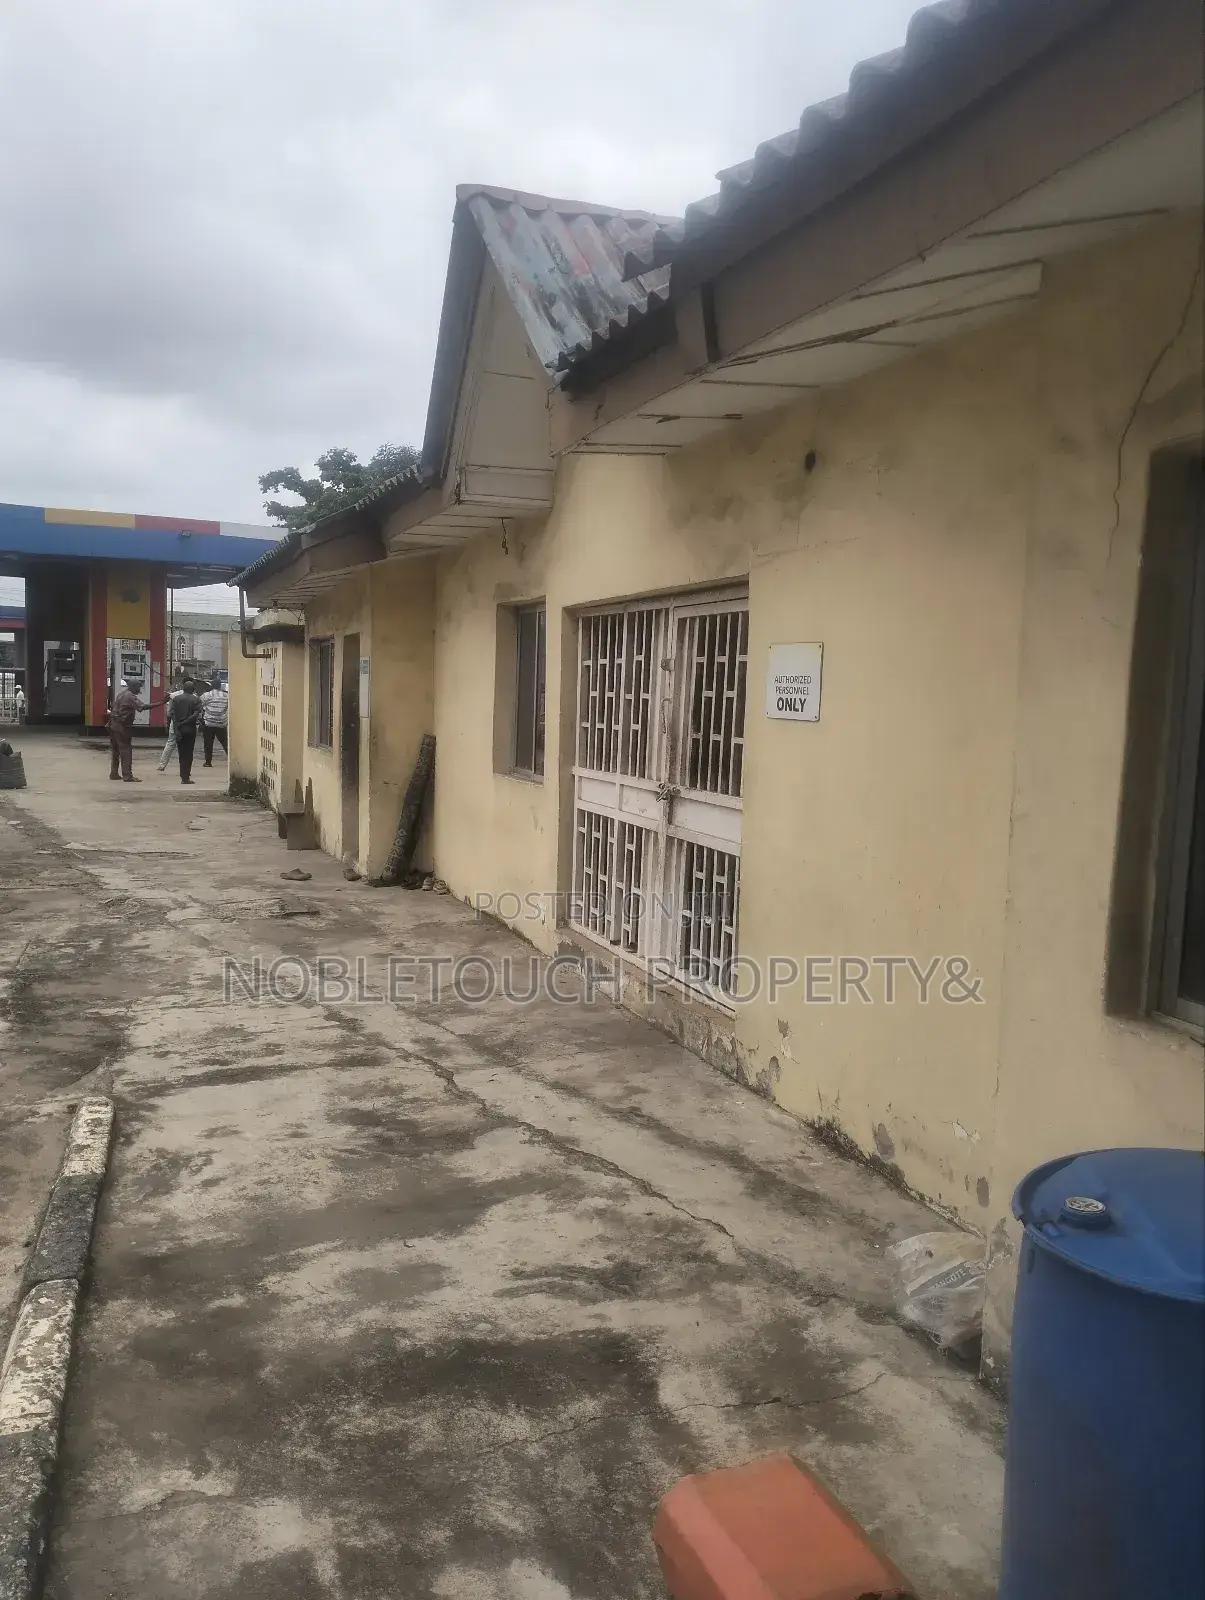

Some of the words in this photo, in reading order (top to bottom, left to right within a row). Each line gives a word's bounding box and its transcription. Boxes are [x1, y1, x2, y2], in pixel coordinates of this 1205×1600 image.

[774, 675, 812, 684] AUTHORIZED
[775, 686, 810, 695] PERSONNEL
[776, 697, 807, 712] ONLY
[933, 1268, 967, 1289] ANGOTE
